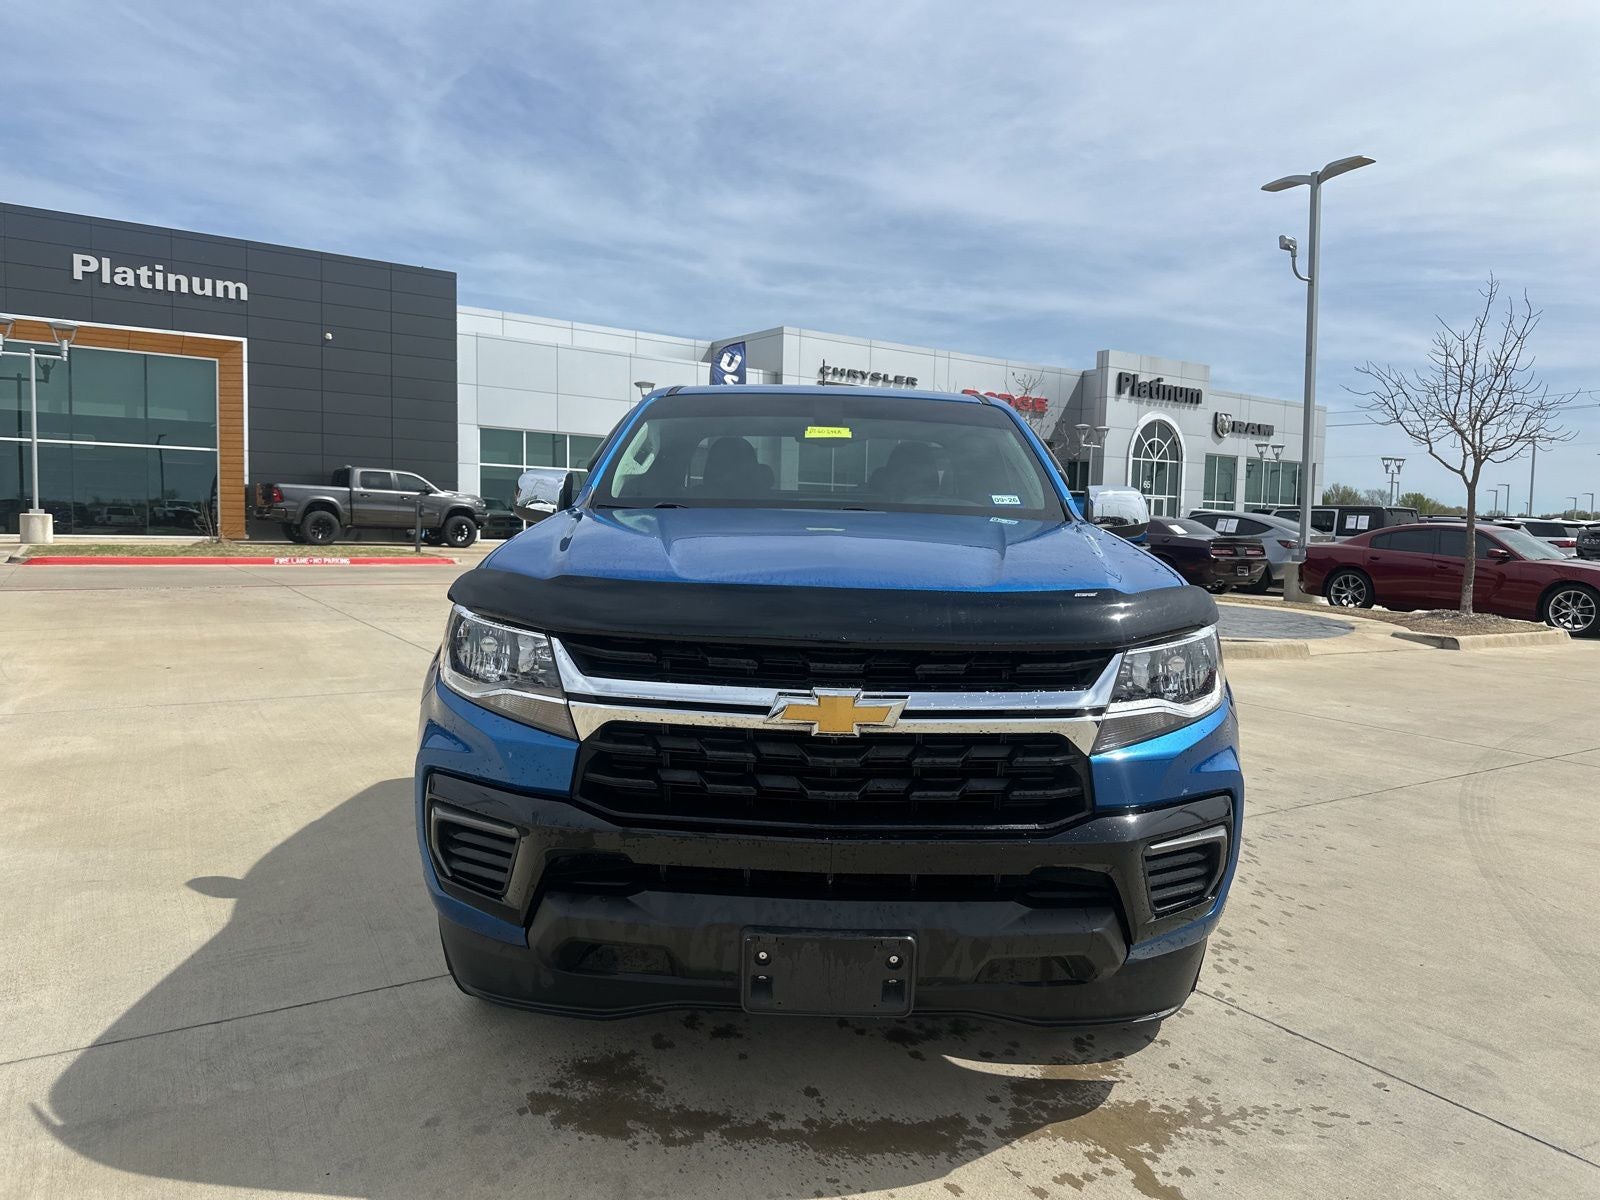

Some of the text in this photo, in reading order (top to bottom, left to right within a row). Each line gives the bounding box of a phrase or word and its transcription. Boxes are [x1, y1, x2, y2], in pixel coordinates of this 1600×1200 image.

[72, 253, 248, 302] Platinum
[818, 365, 918, 386] CHRYSLER
[1115, 371, 1203, 405] Platinum
[961, 389, 1048, 413] DGE
[1231, 420, 1274, 437] RAM
[1143, 480, 1151, 489] 65
[323, 557, 351, 565] PARKING
